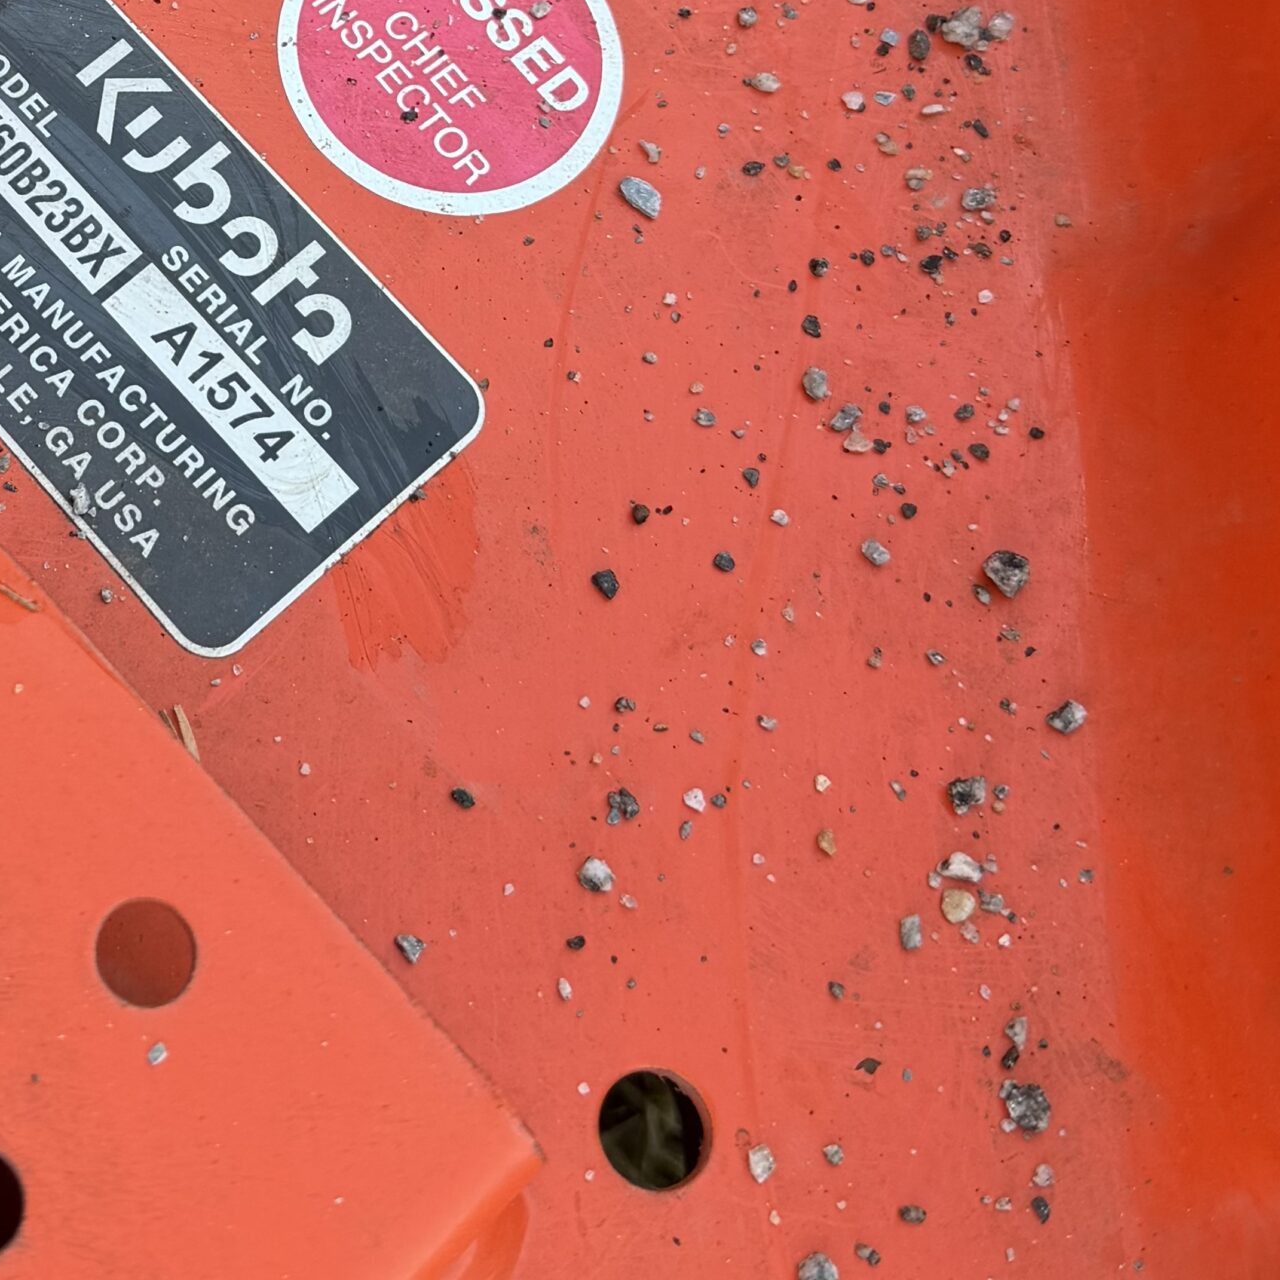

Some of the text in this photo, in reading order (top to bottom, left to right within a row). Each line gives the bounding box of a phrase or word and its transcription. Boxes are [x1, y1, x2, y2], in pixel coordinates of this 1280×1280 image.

[385, 11, 487, 108] CHIEF
[75, 38, 352, 365] Kubota
[1, 254, 256, 536] MANUFACTURING
[150, 321, 296, 465] A1574
[161, 245, 333, 441] SERIAL NO.
[45, 426, 93, 480] GA
[94, 480, 161, 559] USA
[77, 399, 166, 507] CORP.
